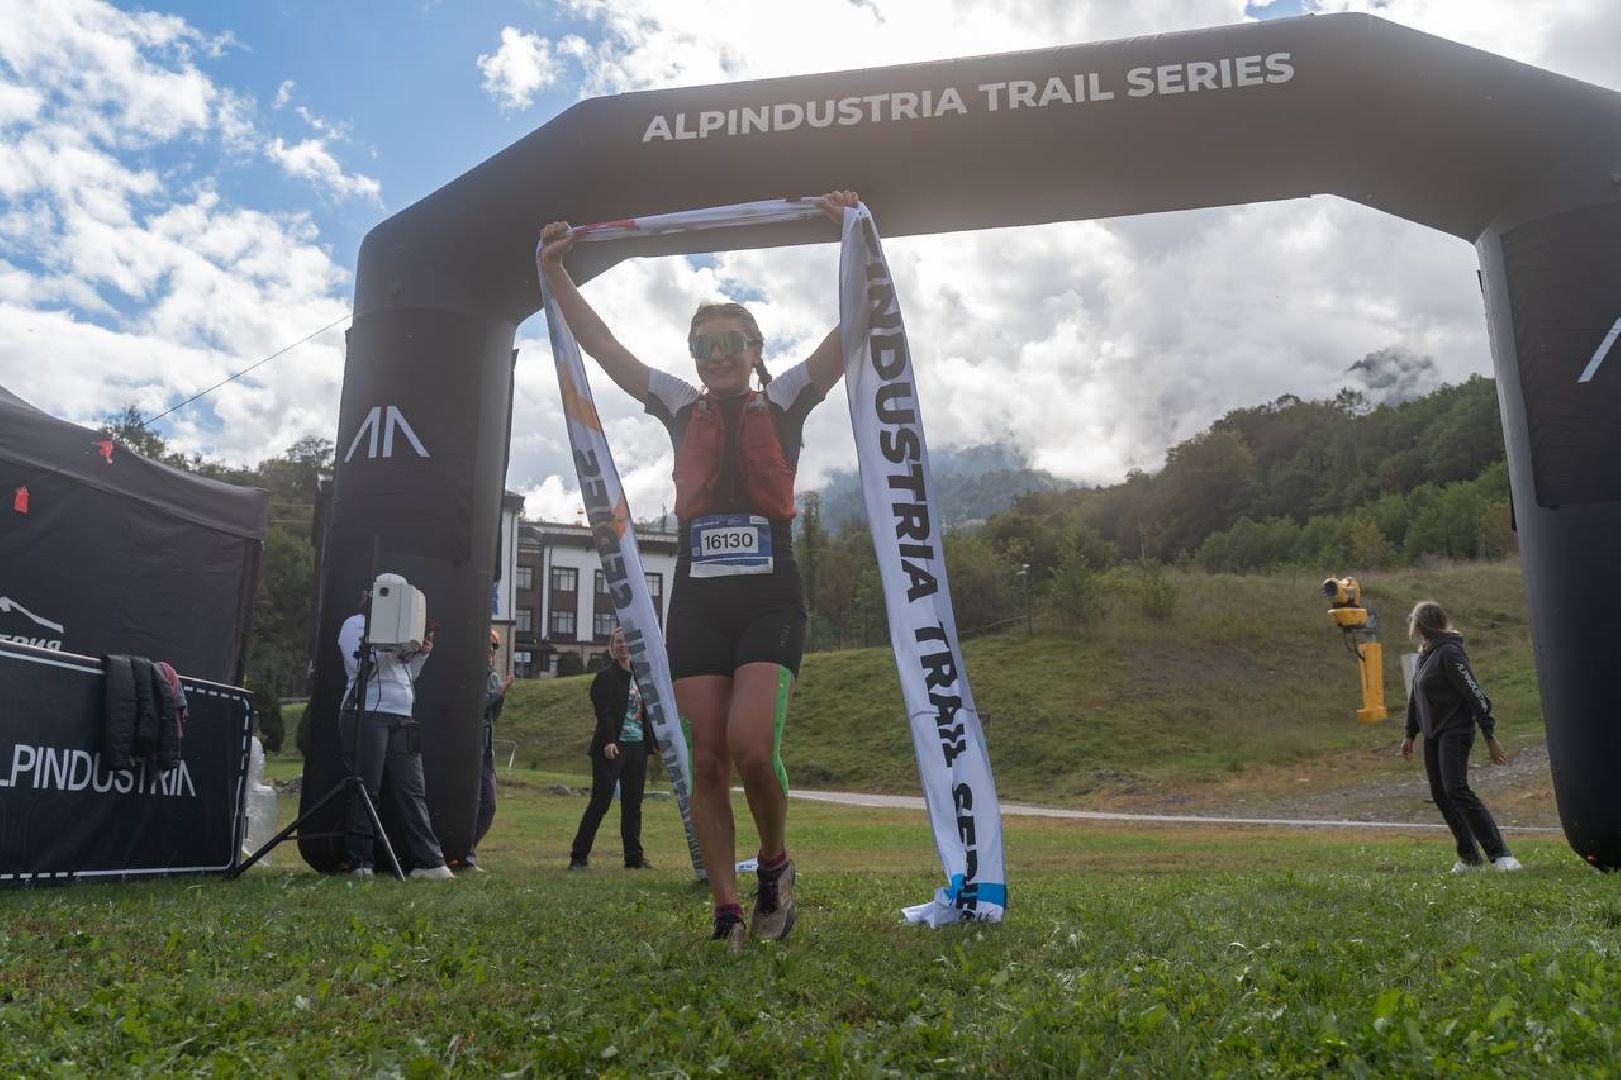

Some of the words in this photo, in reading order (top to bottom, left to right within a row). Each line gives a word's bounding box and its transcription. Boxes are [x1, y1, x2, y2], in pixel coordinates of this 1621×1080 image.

[642, 88, 967, 142] ALPINDUSTRIA
[979, 73, 1114, 112] TRAIL
[1127, 52, 1295, 98] SERIES
[704, 533, 753, 550] 16130
